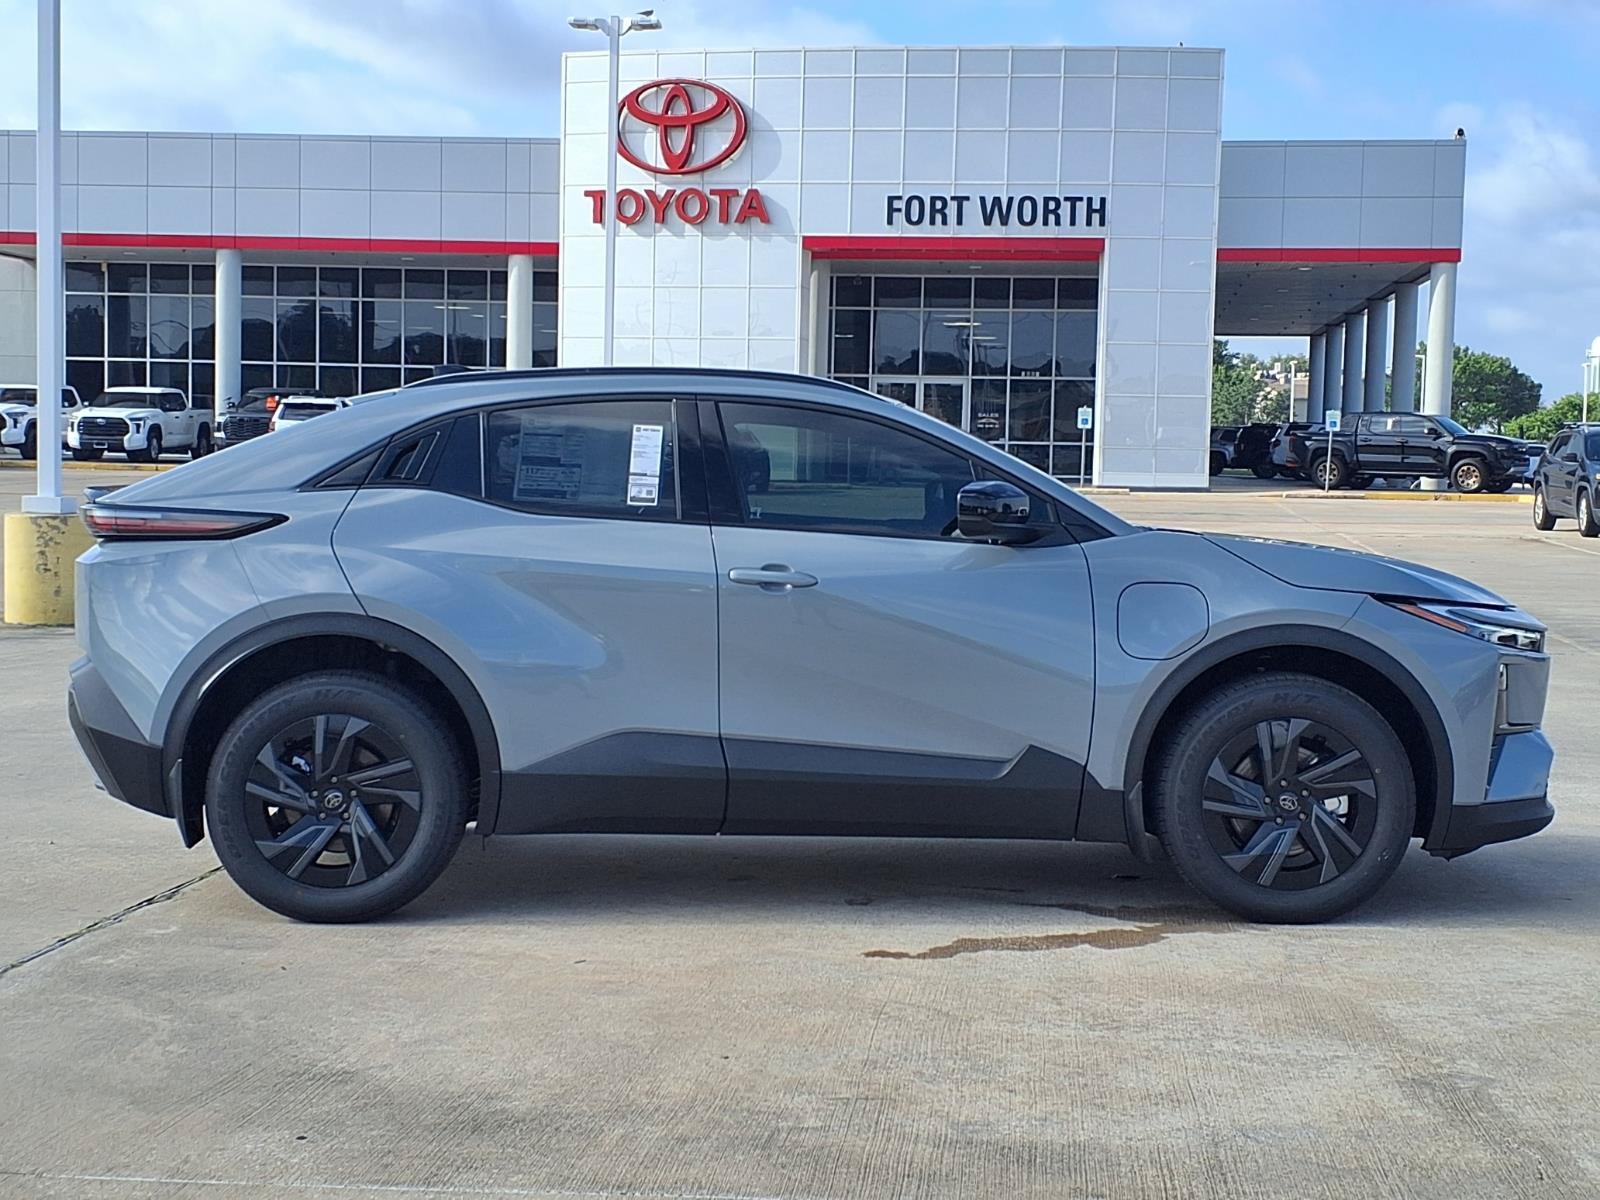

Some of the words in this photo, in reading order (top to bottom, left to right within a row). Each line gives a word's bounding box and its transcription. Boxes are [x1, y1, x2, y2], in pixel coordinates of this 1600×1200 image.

[584, 187, 770, 225] TOYOTA
[886, 195, 970, 226] FORT
[979, 196, 1107, 227] WORTH
